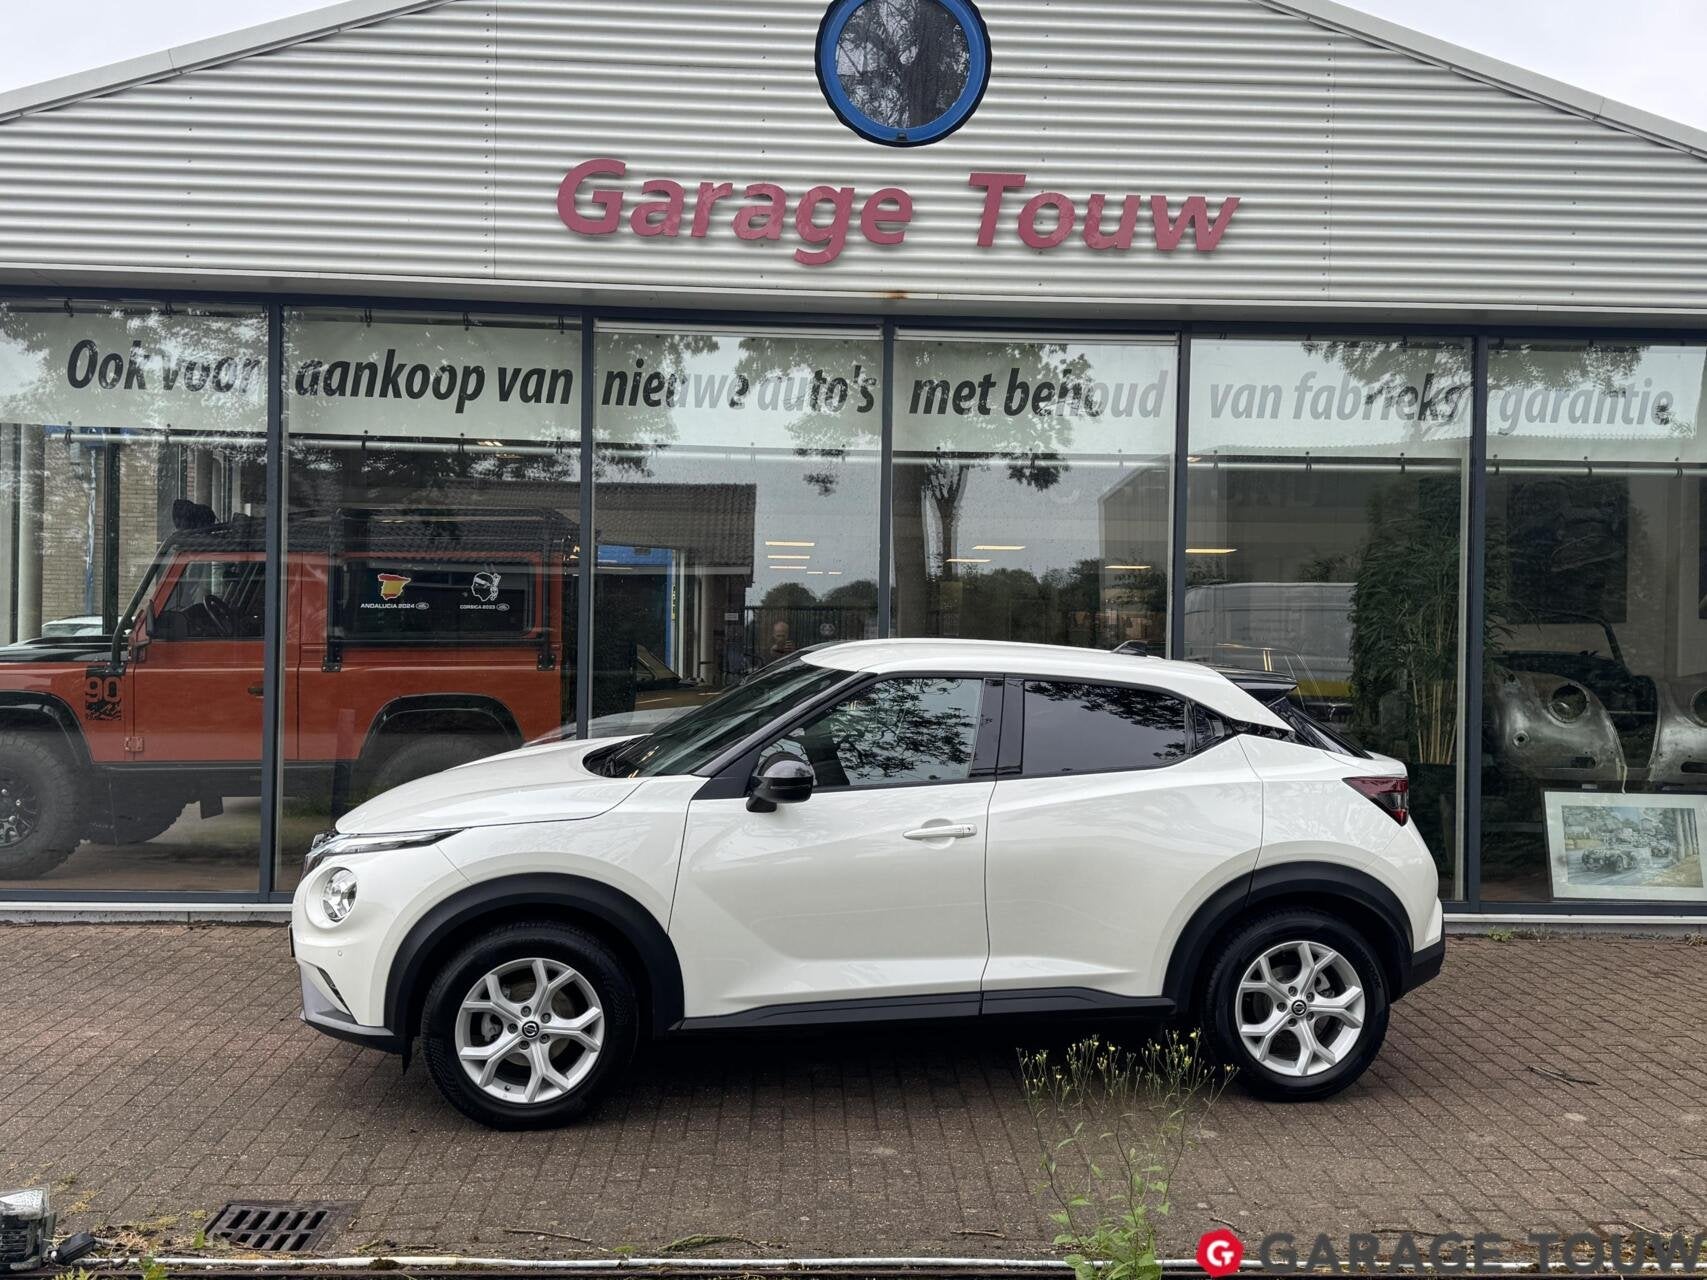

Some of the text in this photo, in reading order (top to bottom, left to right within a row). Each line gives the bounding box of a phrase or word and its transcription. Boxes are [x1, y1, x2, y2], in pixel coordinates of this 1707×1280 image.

[557, 157, 1242, 266] Garage Touw
[67, 338, 153, 391] Ook
[162, 356, 263, 394] voor
[295, 348, 486, 414] aankoop
[498, 366, 573, 404] van
[601, 358, 749, 410] nieuwe
[757, 365, 878, 414] auto's
[909, 367, 996, 415] met
[1004, 366, 1169, 418] behoud
[1210, 382, 1283, 419] van
[1499, 377, 1674, 435] garantie
[86, 676, 122, 703] 90
